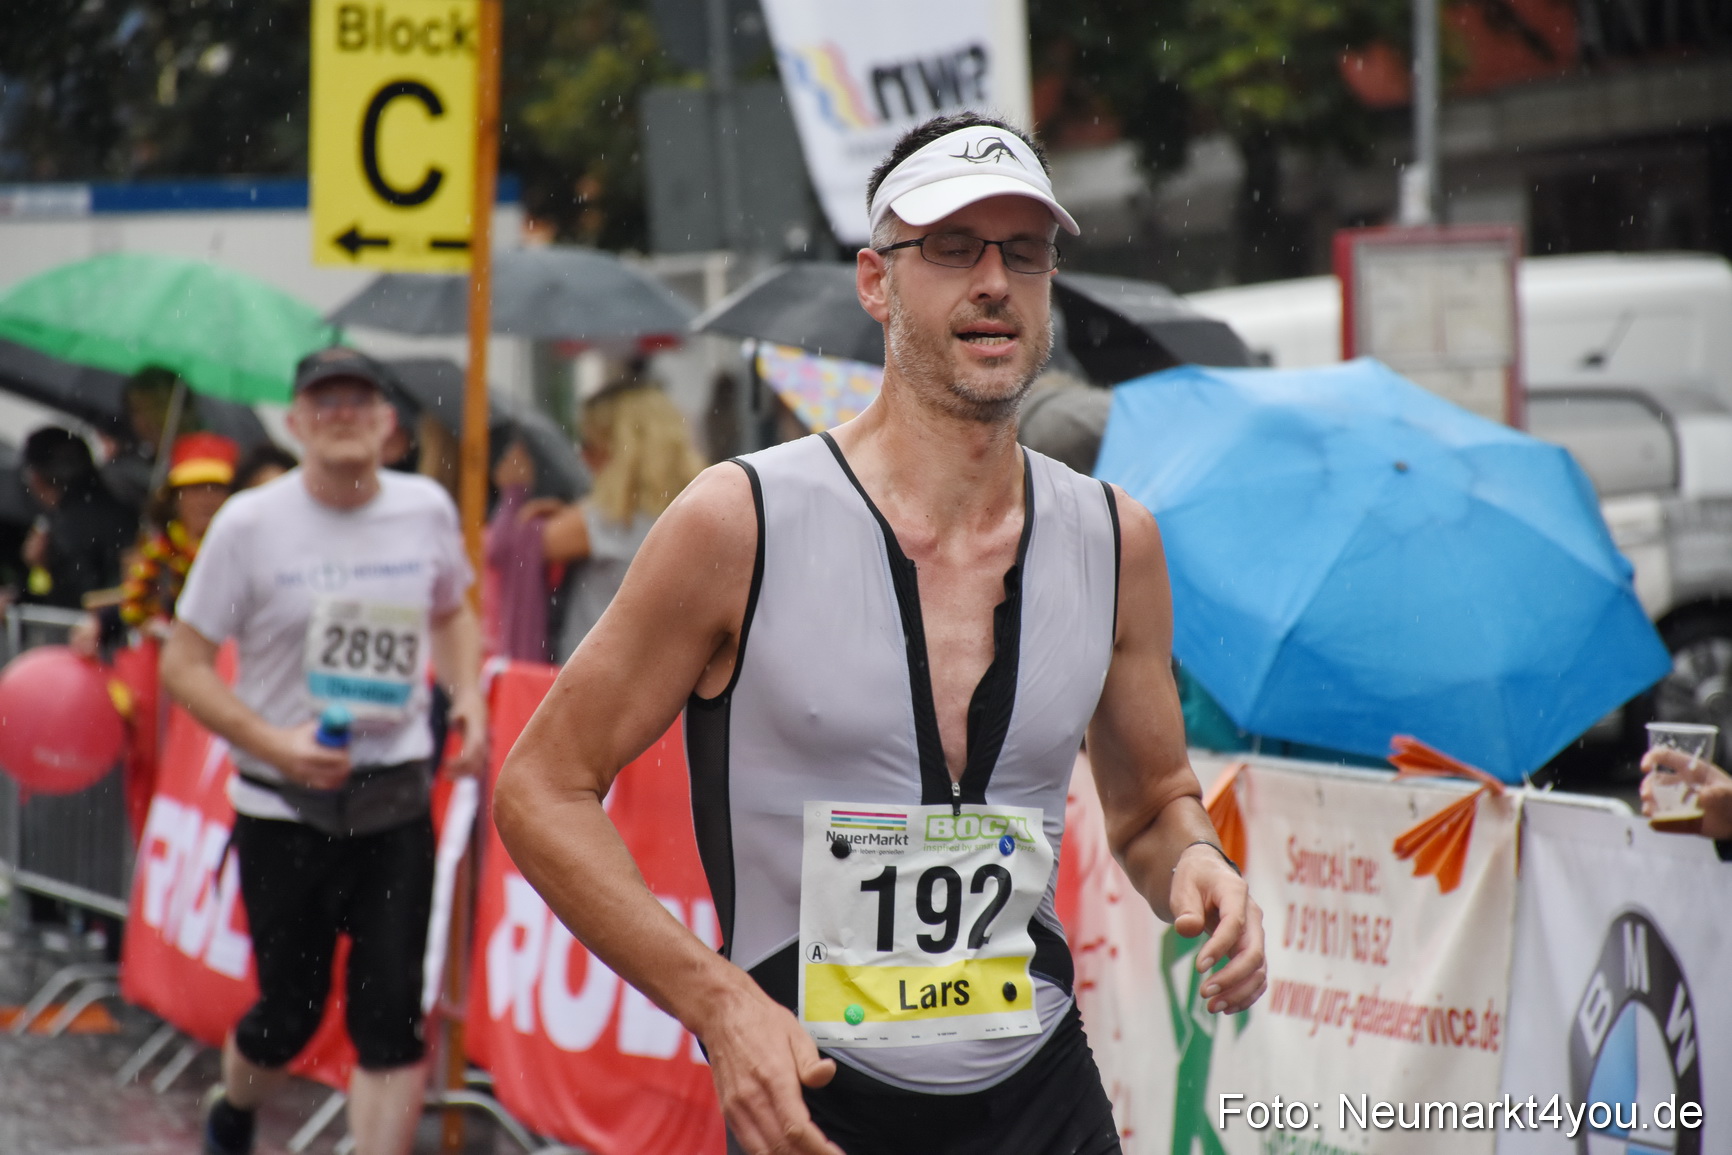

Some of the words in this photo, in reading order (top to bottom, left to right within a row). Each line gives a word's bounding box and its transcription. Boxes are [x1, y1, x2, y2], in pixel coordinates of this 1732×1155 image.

[337, 4, 478, 57] Block
[360, 78, 445, 208] C
[321, 625, 419, 676] 2893
[923, 842, 959, 853] inspired
[962, 842, 972, 853] by
[860, 863, 1012, 954] 192
[811, 944, 823, 960] A
[899, 978, 970, 1011] Lars
[1578, 920, 1697, 1079] BMW
